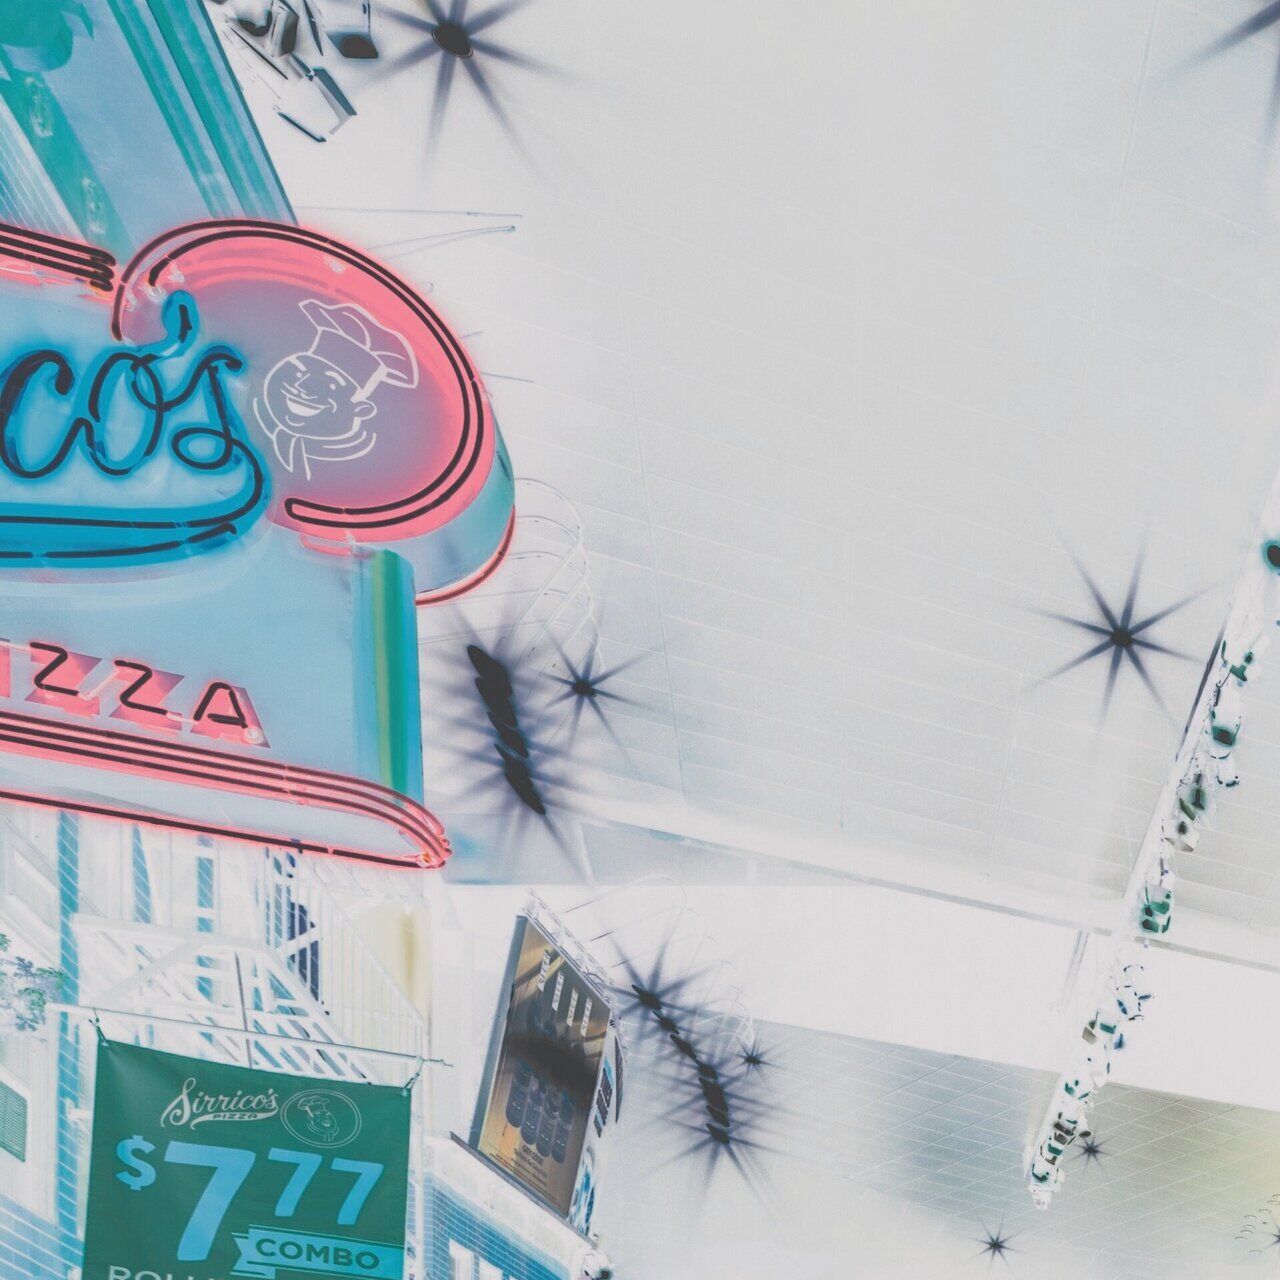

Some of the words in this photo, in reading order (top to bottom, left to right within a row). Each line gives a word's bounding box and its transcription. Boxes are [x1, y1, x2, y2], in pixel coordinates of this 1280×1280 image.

[161, 1077, 279, 1129] Sirrico's
[212, 1112, 258, 1121] PIZZA
[256, 1237, 380, 1270] COMBO
